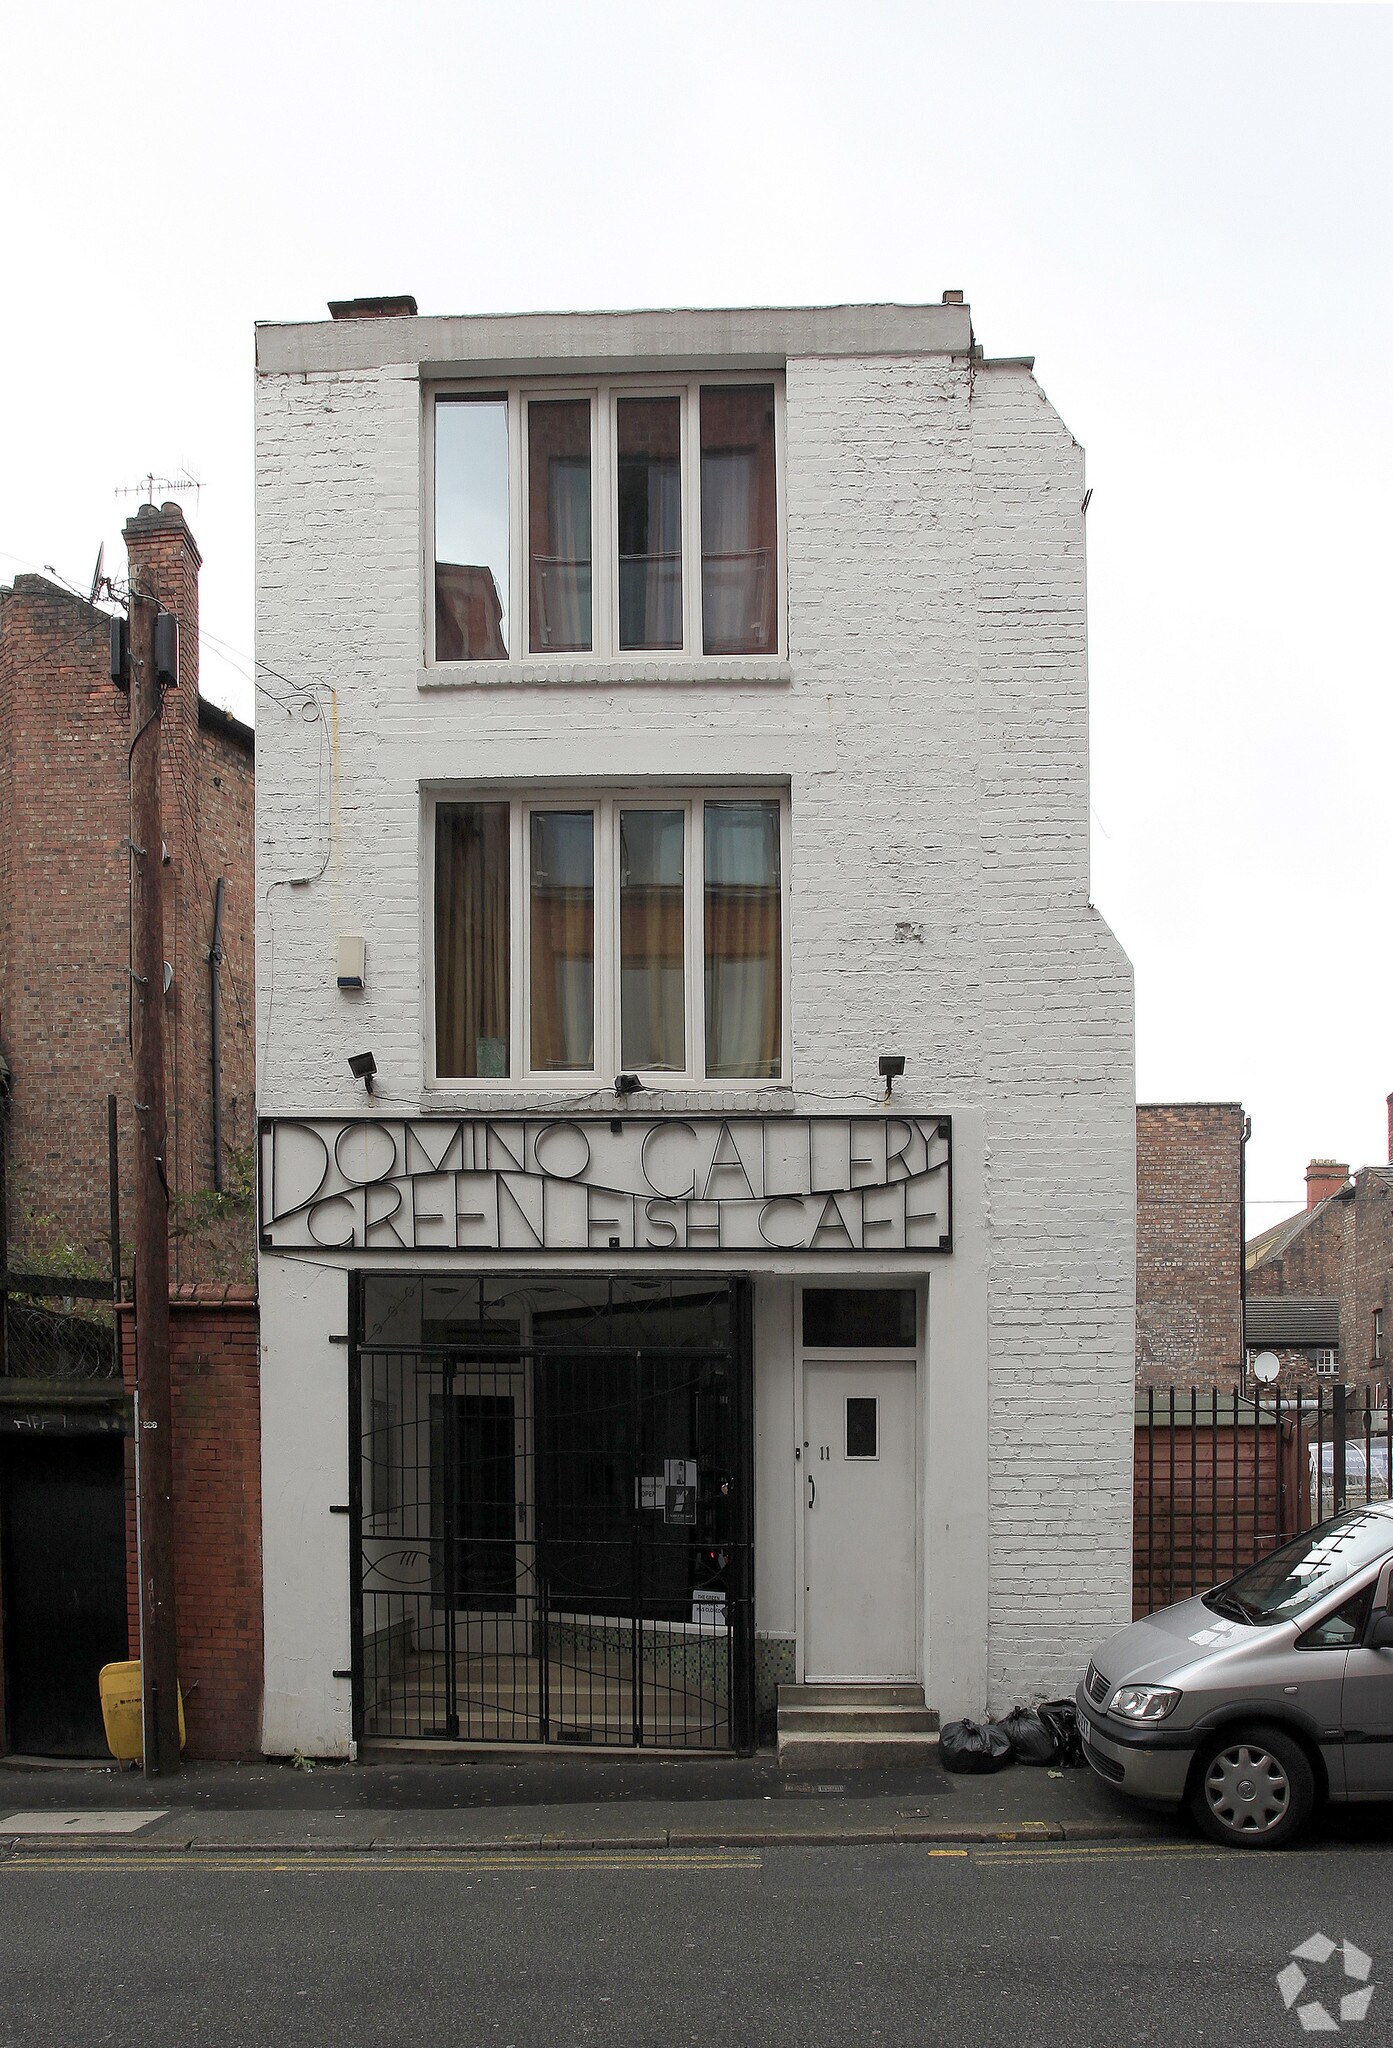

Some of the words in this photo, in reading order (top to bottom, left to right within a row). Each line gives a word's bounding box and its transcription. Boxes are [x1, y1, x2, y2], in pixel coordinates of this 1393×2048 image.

[272, 1119, 591, 1222] DOMINO
[641, 1118, 945, 1200] GALLERY
[307, 1171, 545, 1249] GREEN
[586, 1185, 720, 1249] FISH
[757, 1193, 939, 1249] CAFE
[820, 1446, 830, 1460] 11
